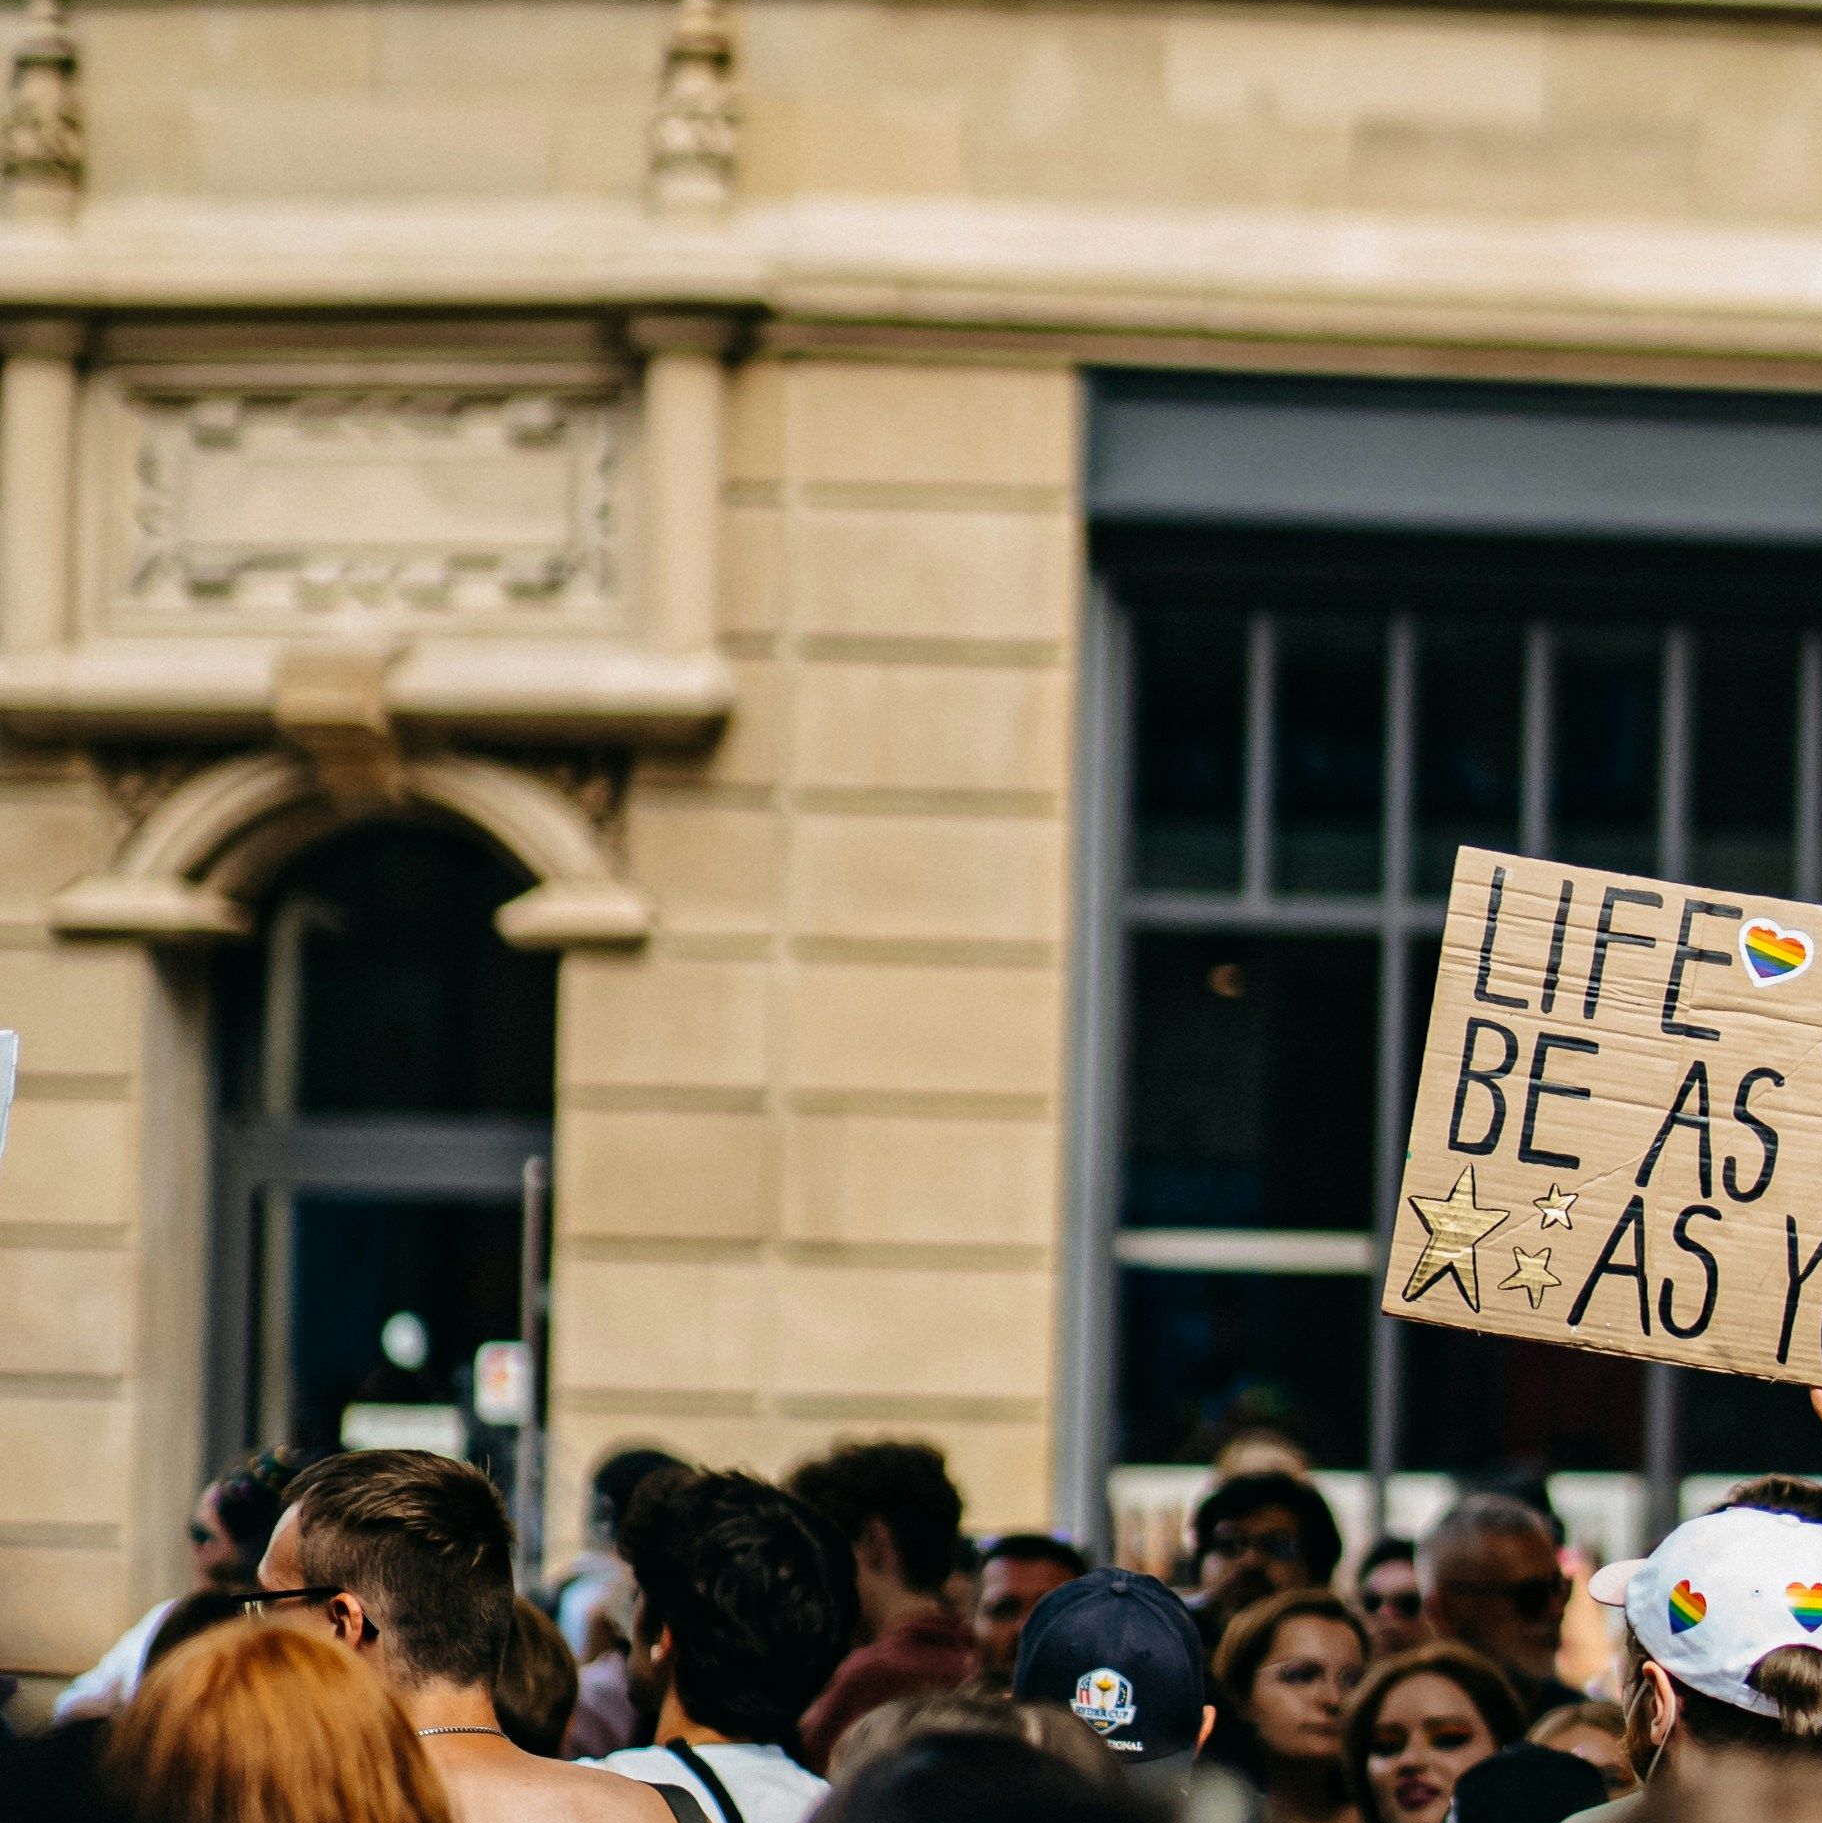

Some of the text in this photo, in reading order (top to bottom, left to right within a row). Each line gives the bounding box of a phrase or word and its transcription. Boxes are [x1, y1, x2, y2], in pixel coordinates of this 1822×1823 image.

[1473, 866, 1743, 1042] LIFE
[1447, 1017, 1600, 1170] BE
[1636, 1060, 1786, 1204] AS
[1566, 1195, 1720, 1341] AS
